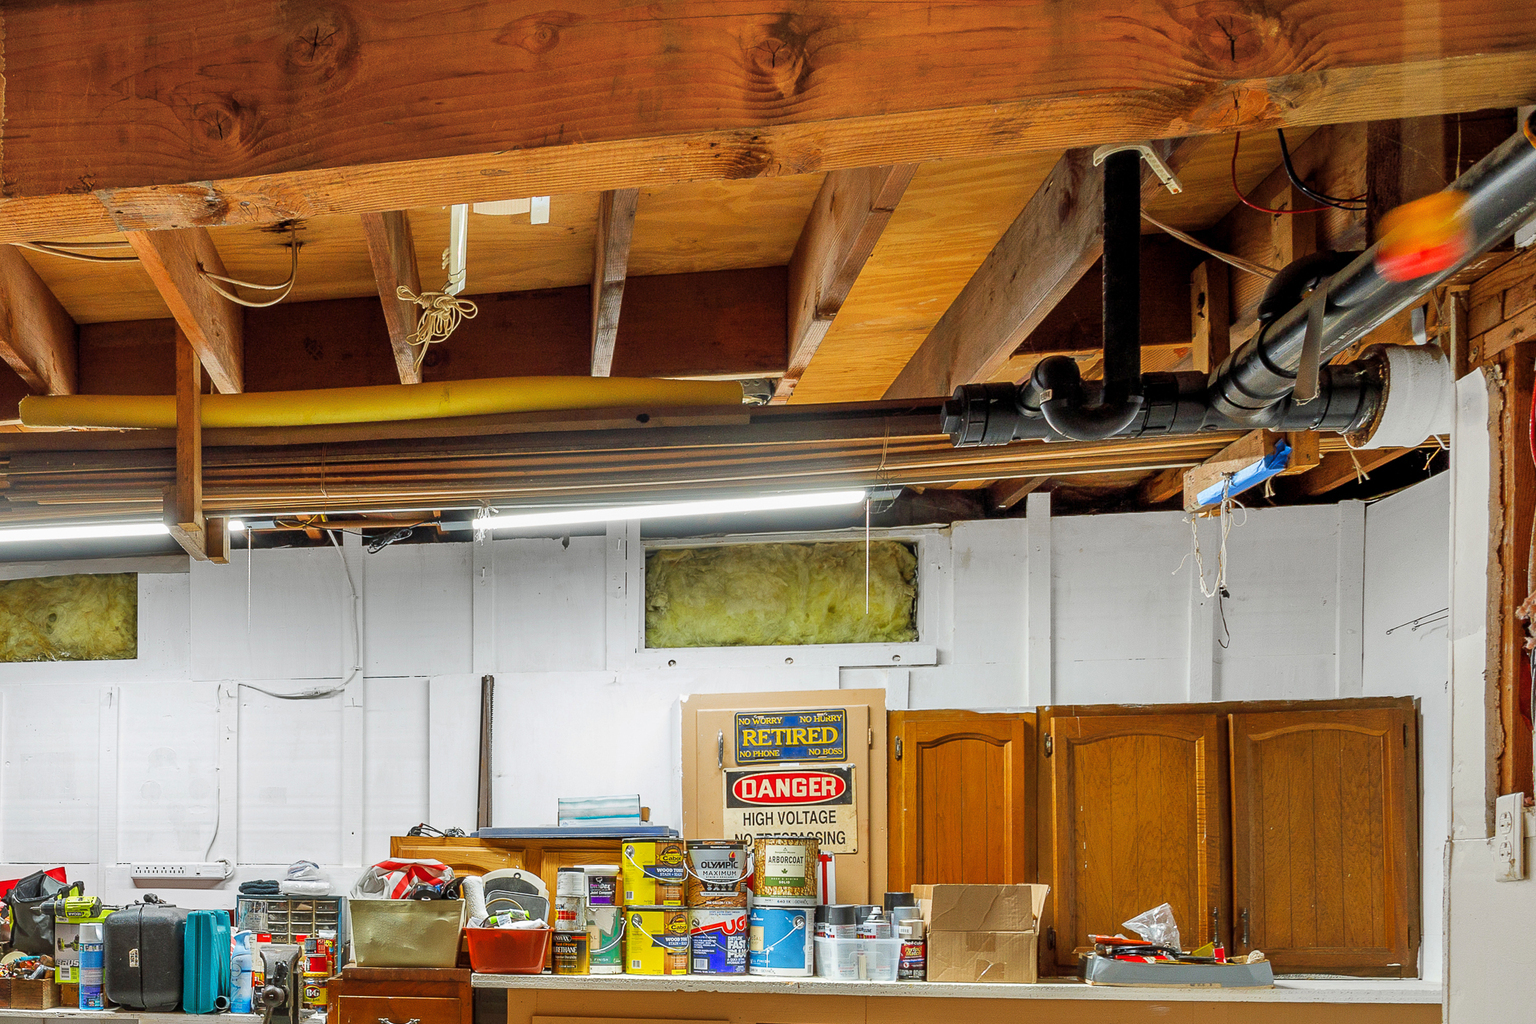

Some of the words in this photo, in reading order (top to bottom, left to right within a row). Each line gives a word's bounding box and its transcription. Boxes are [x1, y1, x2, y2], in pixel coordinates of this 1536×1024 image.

[753, 716, 783, 725] WORRY
[799, 715, 812, 723] NO
[814, 714, 842, 722] HURRY
[742, 726, 839, 746] RETIRED
[753, 749, 780, 757] PHONE
[822, 747, 843, 755] BOSS
[741, 777, 837, 799] DANGER
[743, 811, 774, 826] HIGH
[777, 810, 837, 825] VOLTAGE
[734, 833, 753, 847] NO
[700, 861, 739, 869] OLYMPIC
[727, 940, 746, 949] FAST
